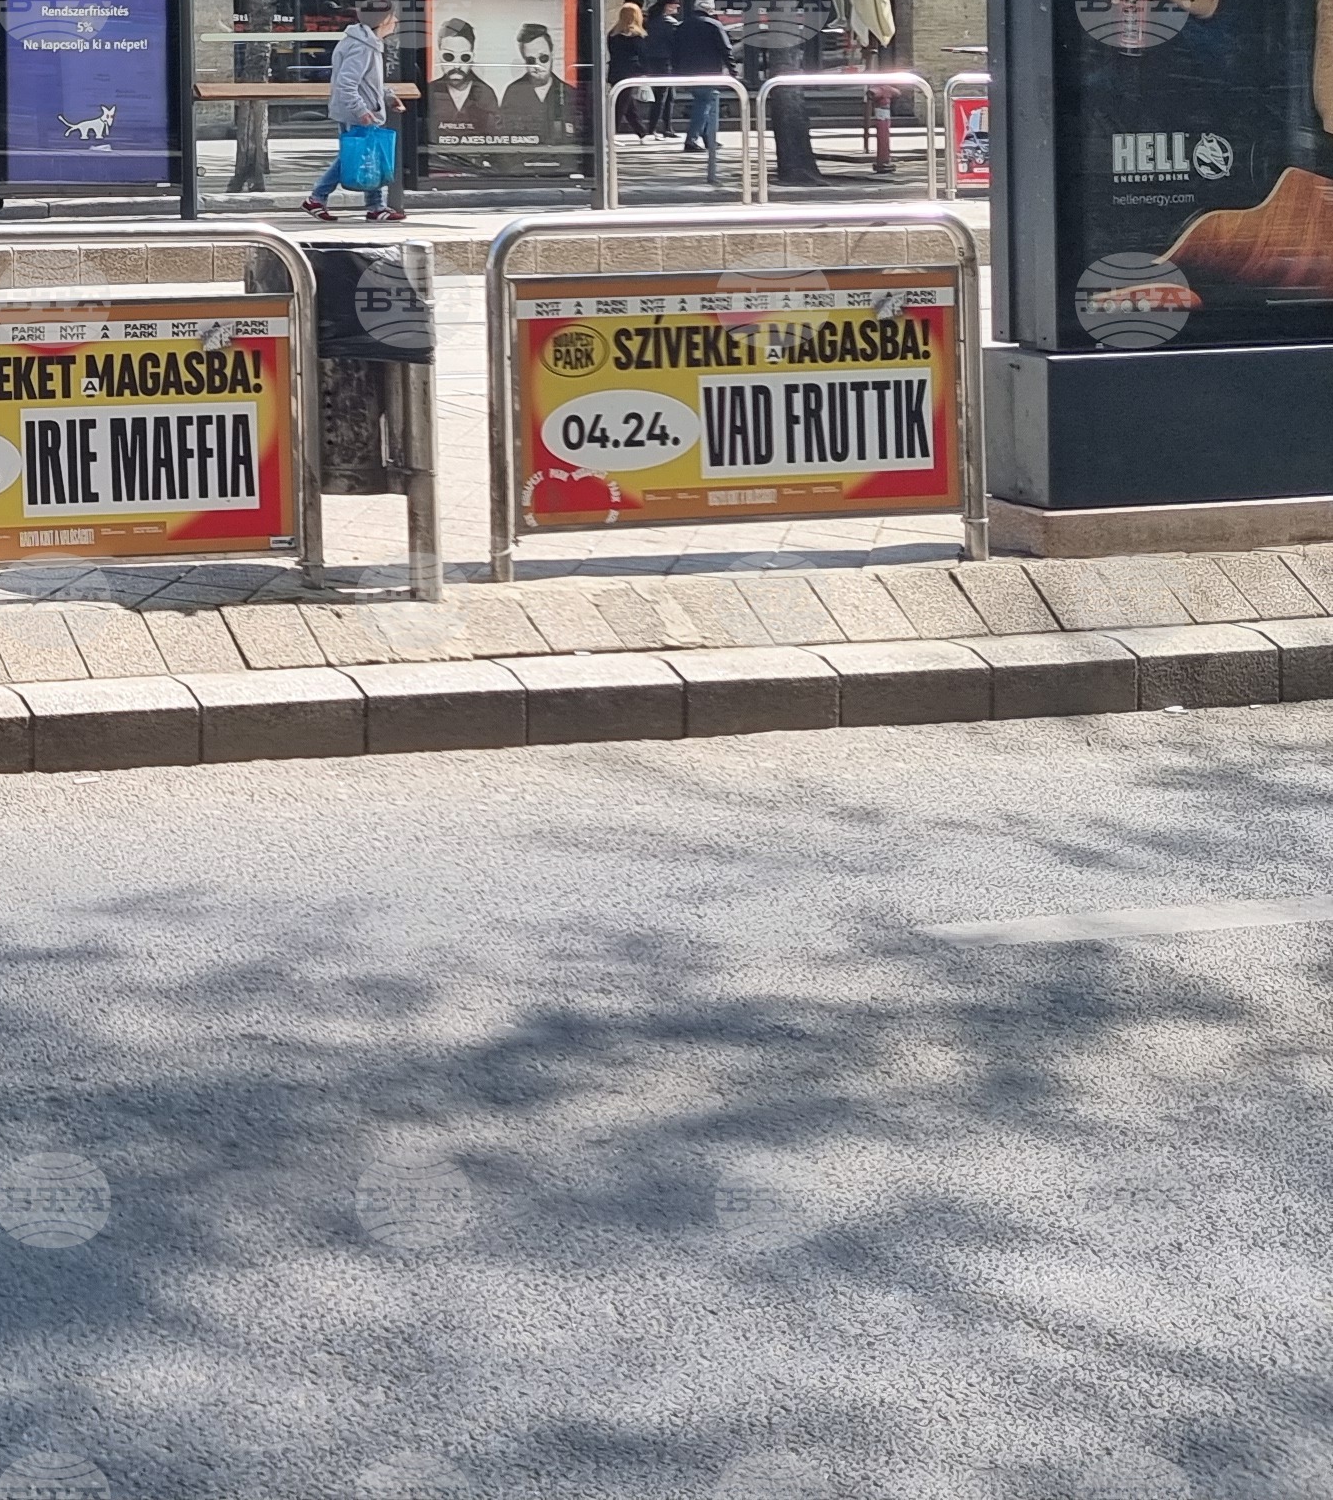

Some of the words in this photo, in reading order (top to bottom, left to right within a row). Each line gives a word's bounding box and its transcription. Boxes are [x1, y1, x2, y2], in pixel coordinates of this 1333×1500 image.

[42, 5, 129, 16] Rendszerfrissítés
[76, 22, 93, 33] 5%
[23, 40, 38, 50] Ne
[41, 39, 90, 52] kapcsolja
[92, 40, 102, 50] ki
[105, 42, 111, 50] a
[113, 39, 148, 53] népet!
[439, 135, 459, 144] RED
[1112, 132, 1190, 174] HELL
[613, 315, 760, 370] SZÍVEKET
[767, 348, 781, 360] A
[769, 319, 931, 365] MAGASBA!
[552, 347, 595, 369] PARK
[83, 380, 98, 393] A
[85, 350, 263, 398] MAGASBA!
[562, 411, 681, 450] 04.24.
[702, 385, 775, 468] VAD
[786, 378, 930, 464] FRUTTIK
[25, 417, 100, 506] IRIE
[111, 413, 257, 502] MAFFIA
